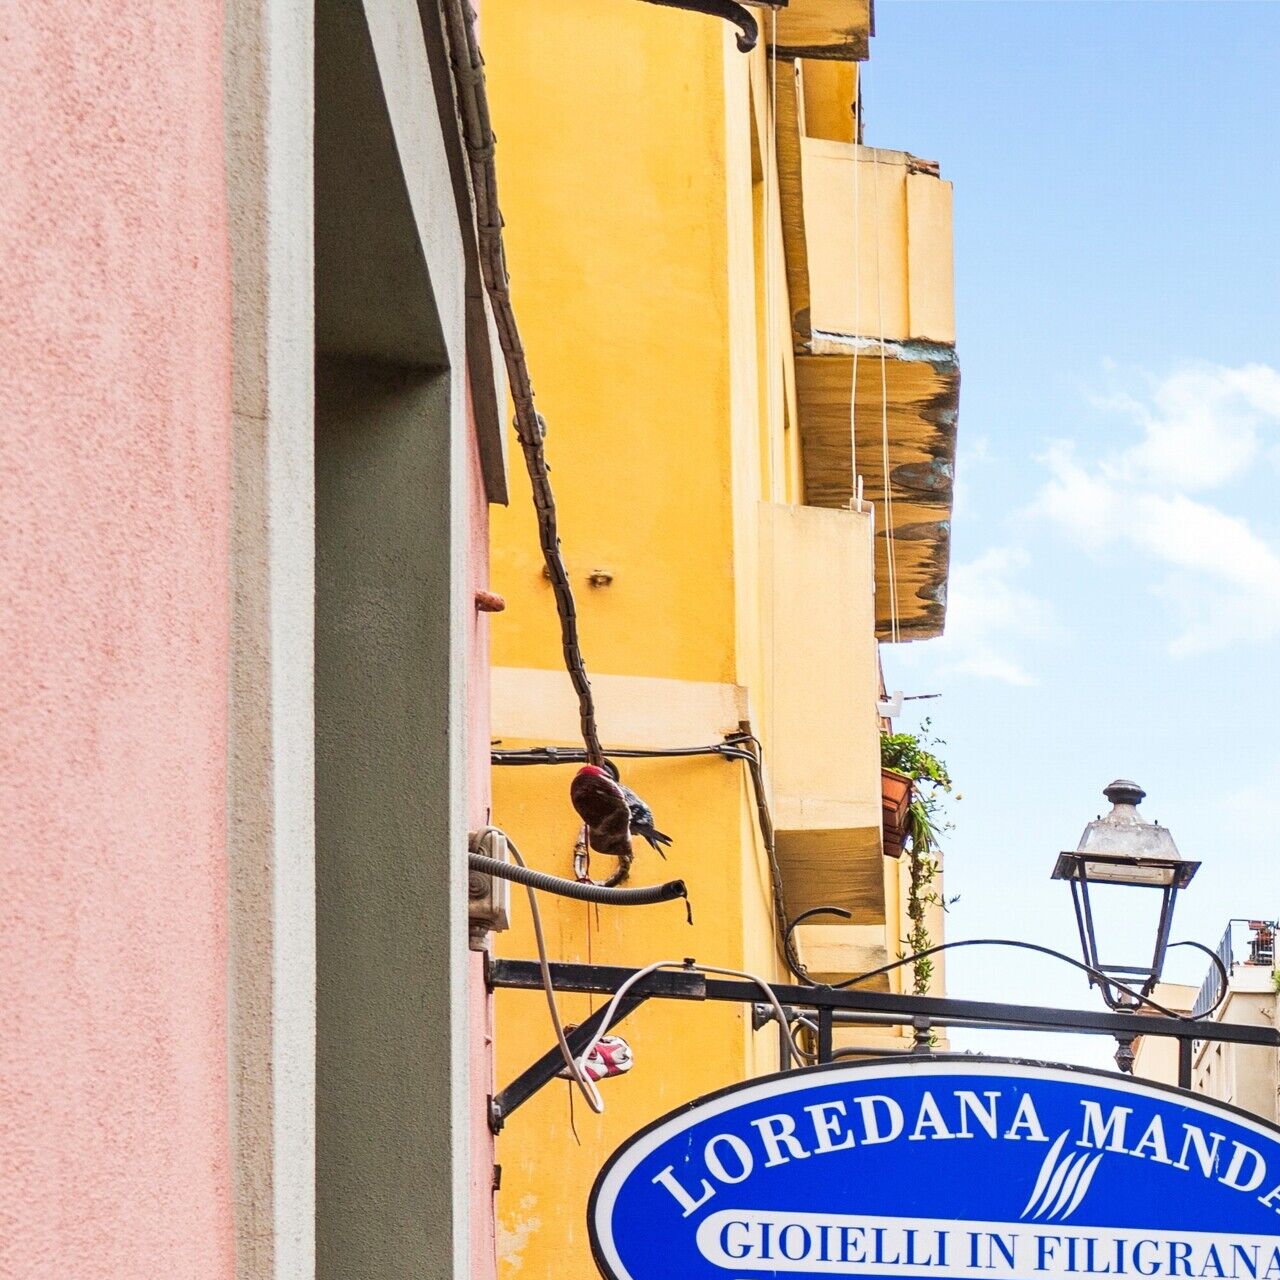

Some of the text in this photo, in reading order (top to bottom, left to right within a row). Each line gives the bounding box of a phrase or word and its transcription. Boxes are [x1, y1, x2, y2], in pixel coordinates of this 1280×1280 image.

[652, 1090, 1049, 1218] LOREDANA
[719, 1220, 950, 1267] GIOIELLI
[967, 1231, 1019, 1271] IN
